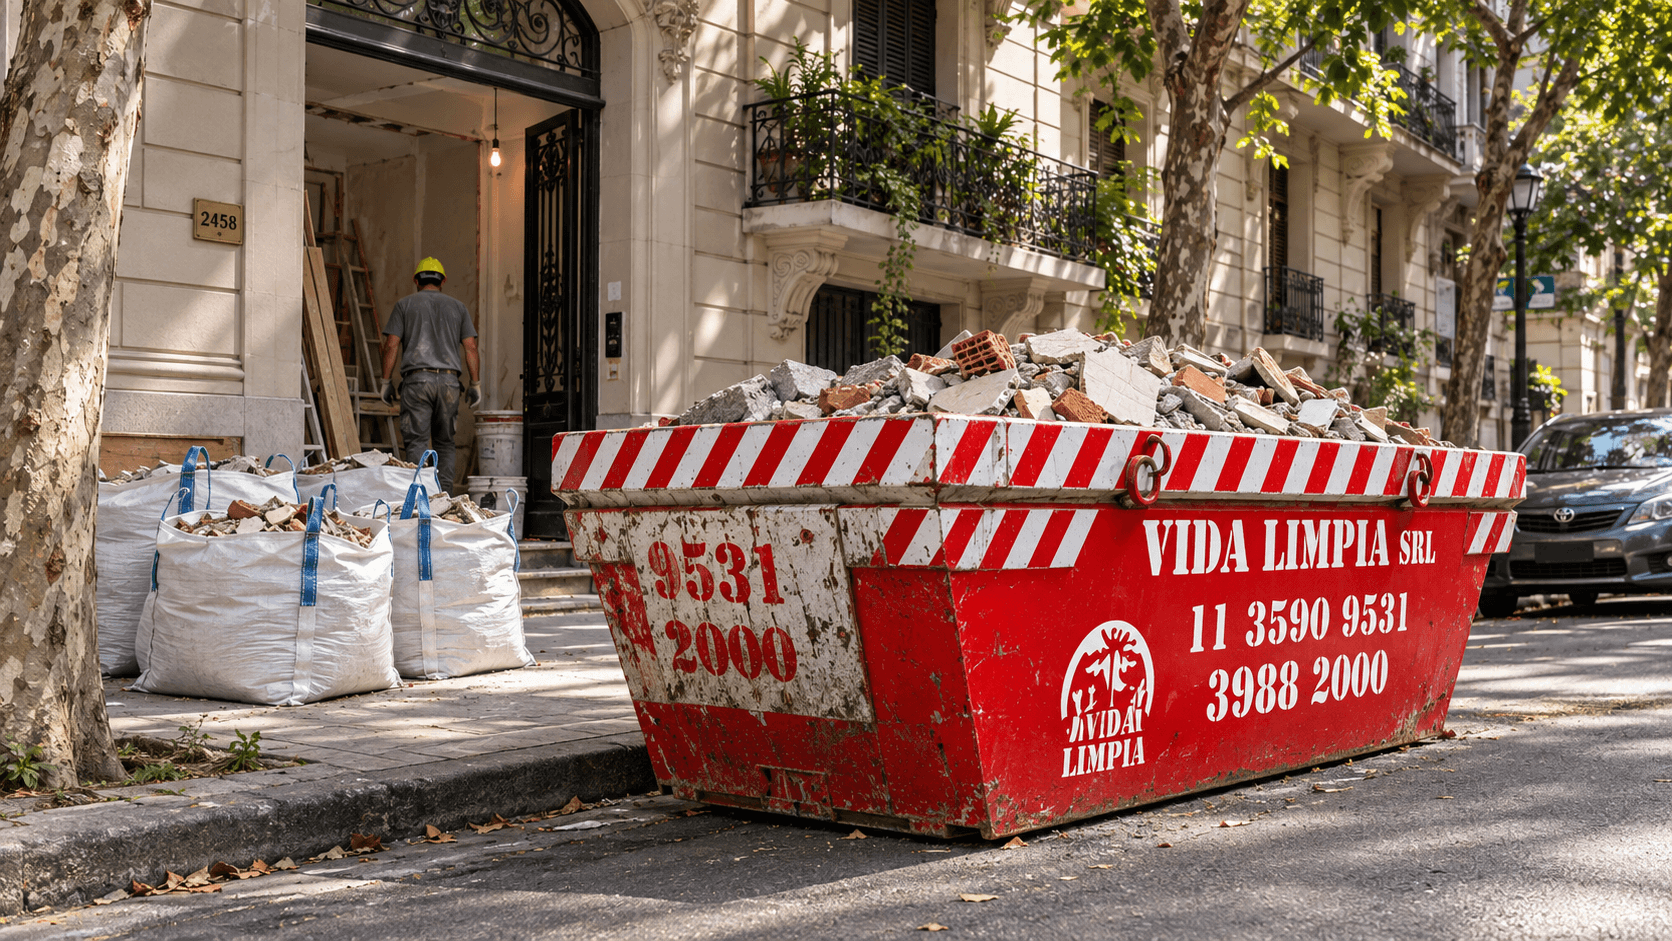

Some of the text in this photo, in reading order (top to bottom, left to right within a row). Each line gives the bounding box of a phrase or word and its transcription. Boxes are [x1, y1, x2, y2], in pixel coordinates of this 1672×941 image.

[200, 211, 237, 231] 2458
[648, 540, 785, 604] 9531
[1143, 519, 1436, 576] VIDA LIMPIA SRL
[665, 620, 797, 682] 2000
[1190, 592, 1408, 653] 11 3590 9531
[1206, 649, 1388, 722] 3988 2000
[1061, 736, 1146, 778] LIMPIA
